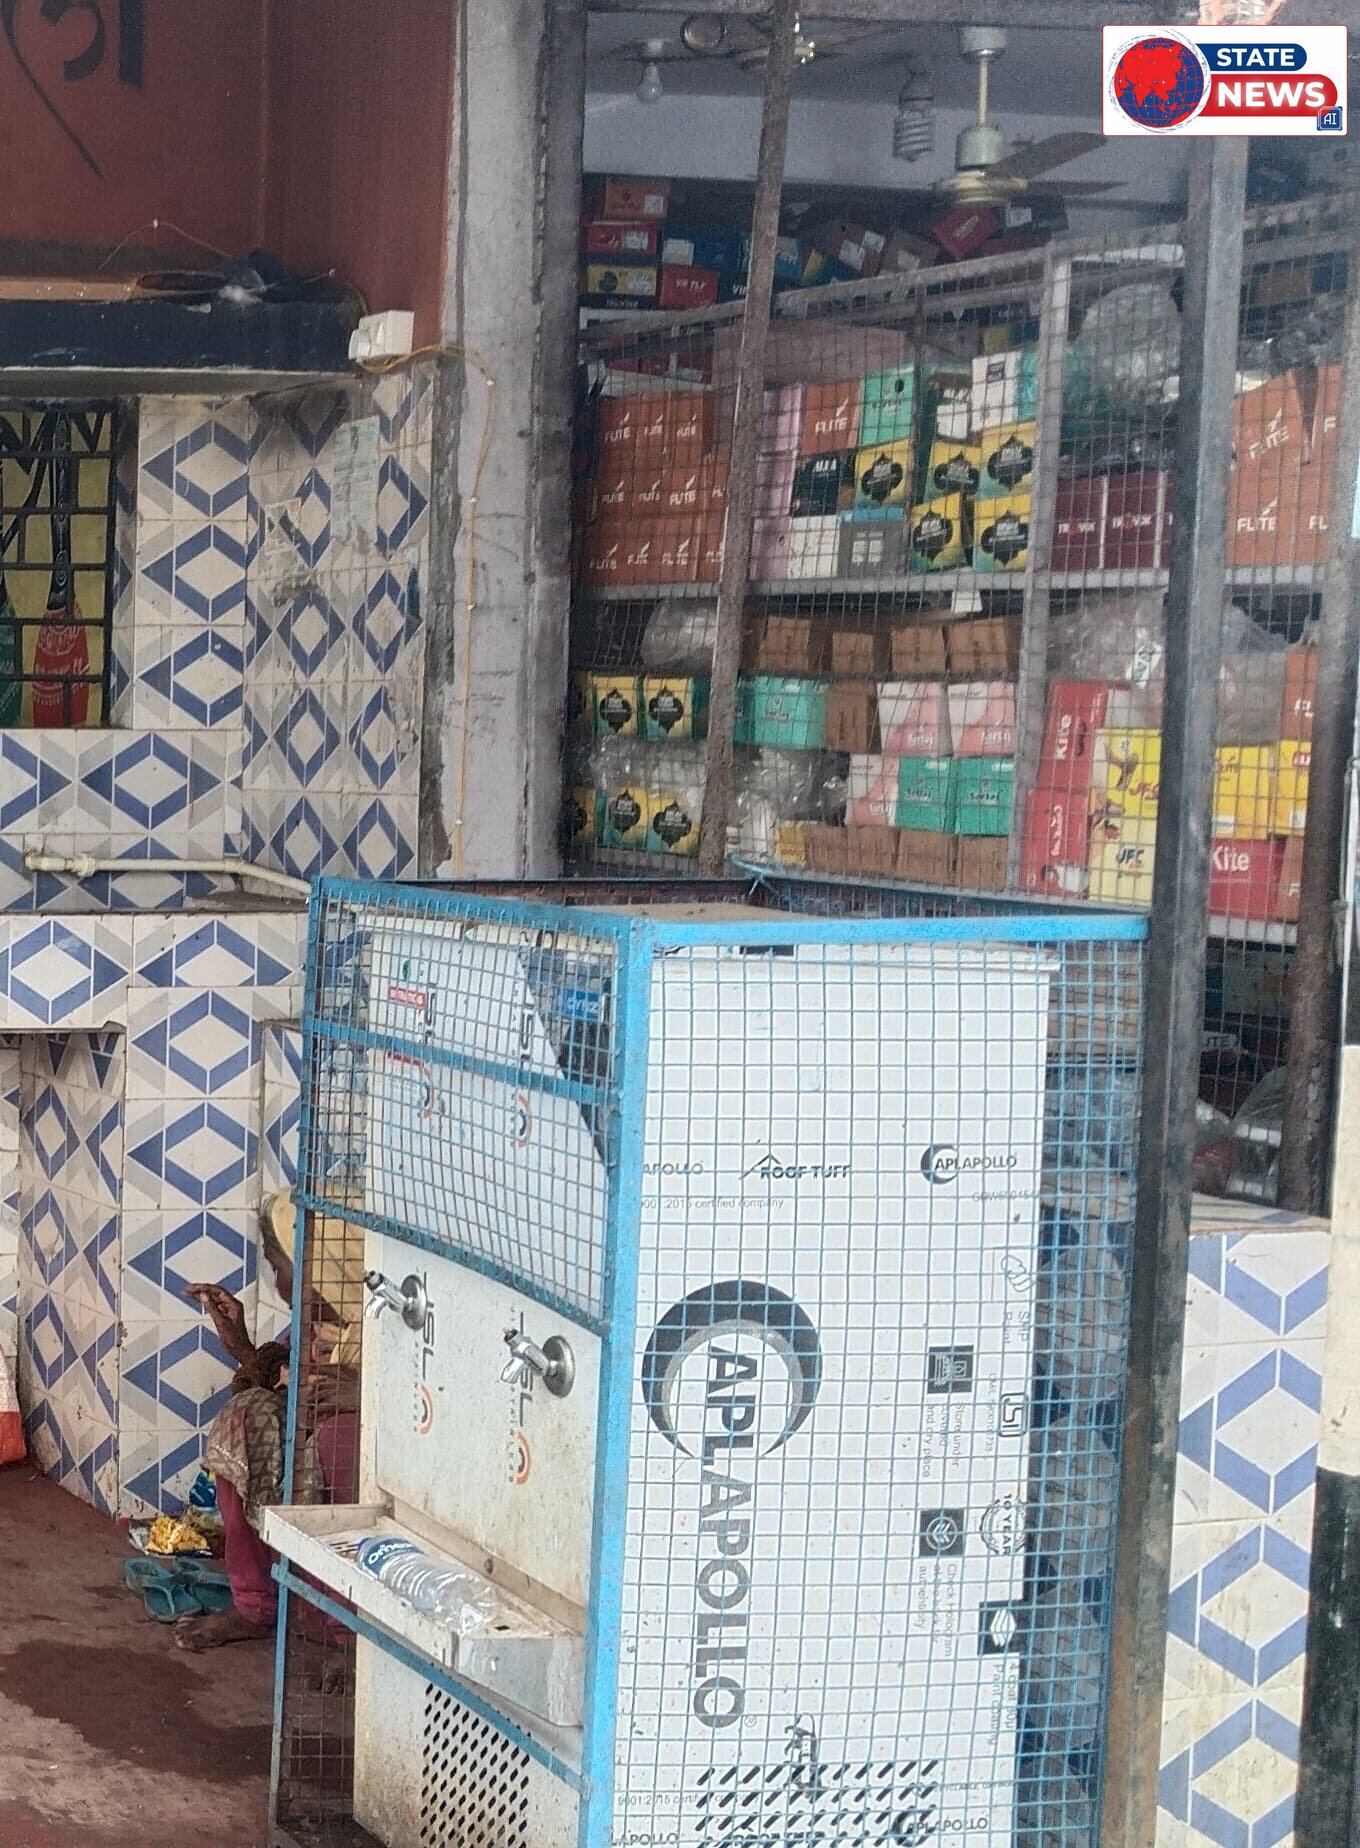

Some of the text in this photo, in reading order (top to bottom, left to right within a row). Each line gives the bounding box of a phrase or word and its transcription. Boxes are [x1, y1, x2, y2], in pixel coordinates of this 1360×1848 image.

[695, 1198, 736, 1209] certfied
[738, 1199, 785, 1212] compny
[951, 1435, 964, 1468] undr
[1002, 1514, 1013, 1557] YEAR
